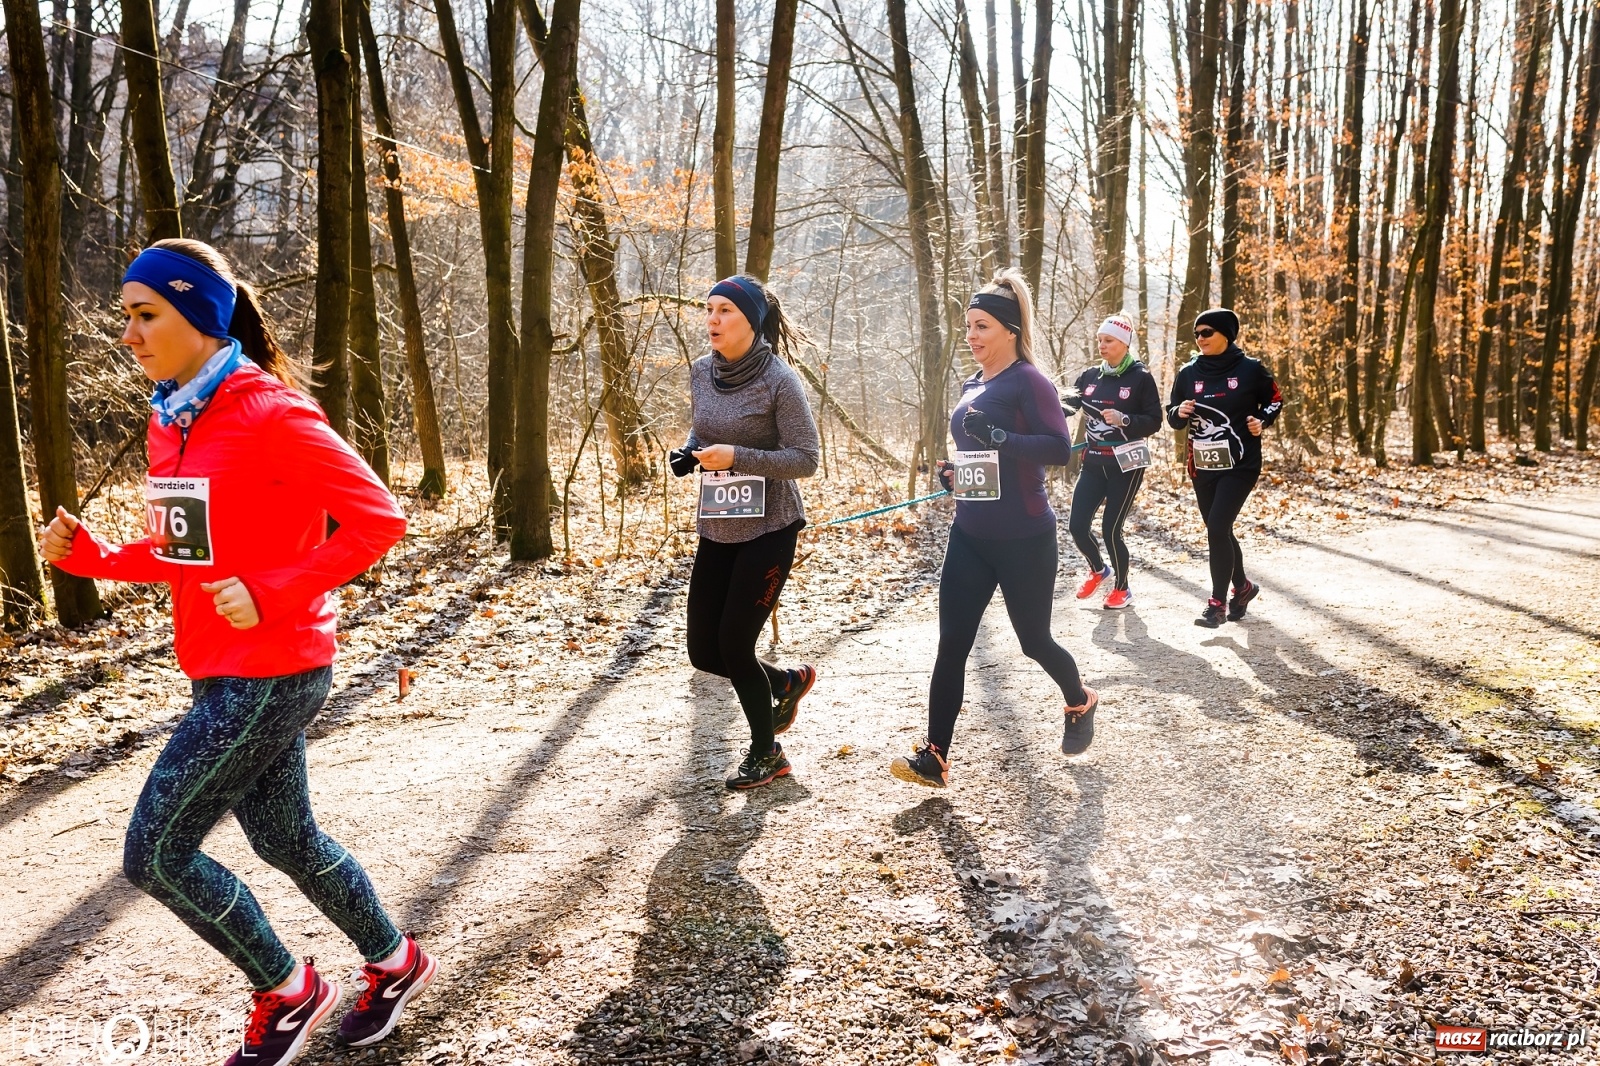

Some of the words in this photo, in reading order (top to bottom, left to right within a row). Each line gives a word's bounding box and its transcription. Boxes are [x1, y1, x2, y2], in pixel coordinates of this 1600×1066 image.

[168, 280, 194, 292] 4F
[1125, 449, 1145, 462] 157
[1199, 451, 1220, 462] 123
[958, 467, 986, 485] 096
[714, 485, 752, 503] 009
[147, 502, 188, 538] 076
